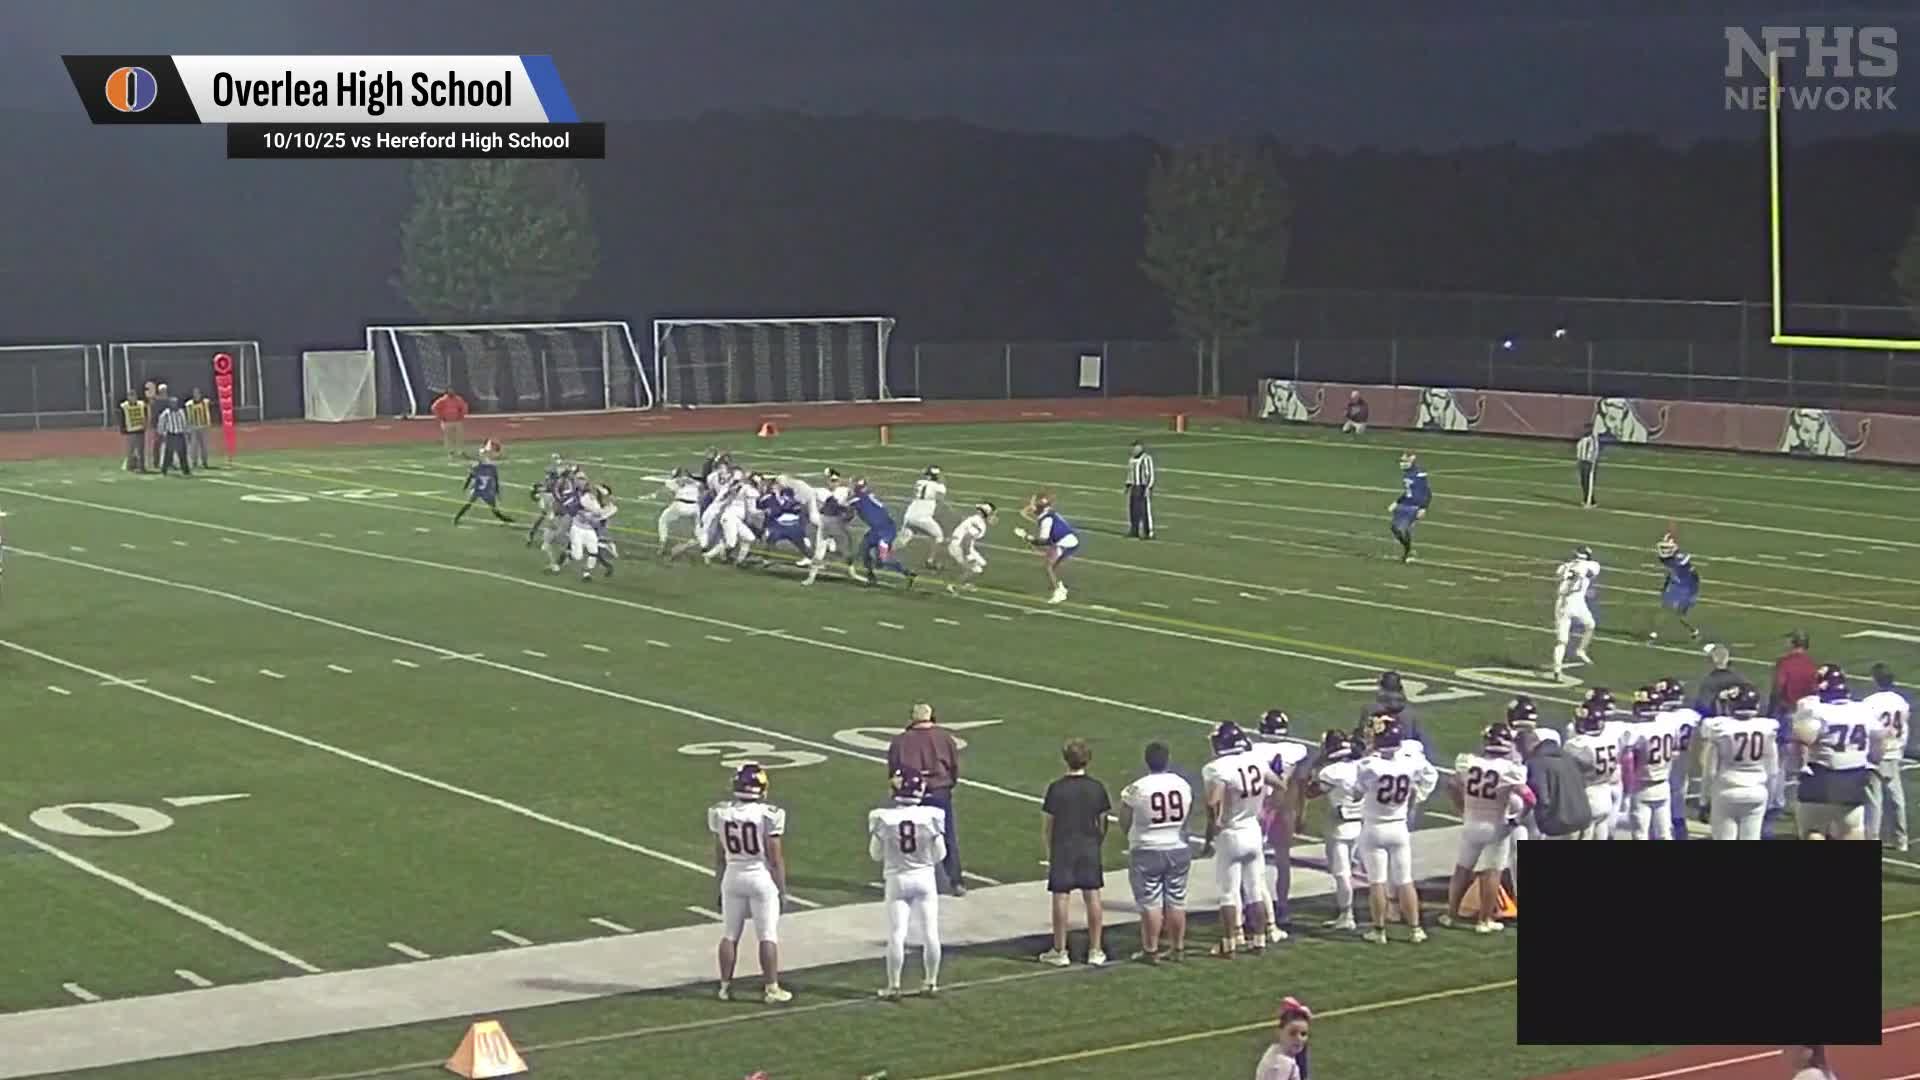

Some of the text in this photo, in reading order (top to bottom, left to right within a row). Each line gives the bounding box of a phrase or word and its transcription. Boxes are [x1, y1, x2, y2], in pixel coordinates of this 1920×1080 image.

[1649, 733, 1674, 765] 20
[1733, 731, 1765, 761] 70
[1827, 723, 1868, 752] 74
[1594, 744, 1617, 775] 55
[1237, 765, 1263, 799] 12
[1376, 773, 1411, 805] 28
[1466, 766, 1500, 800] 22
[1150, 790, 1185, 825] 99
[724, 820, 761, 856] 60
[899, 819, 918, 853] 8
